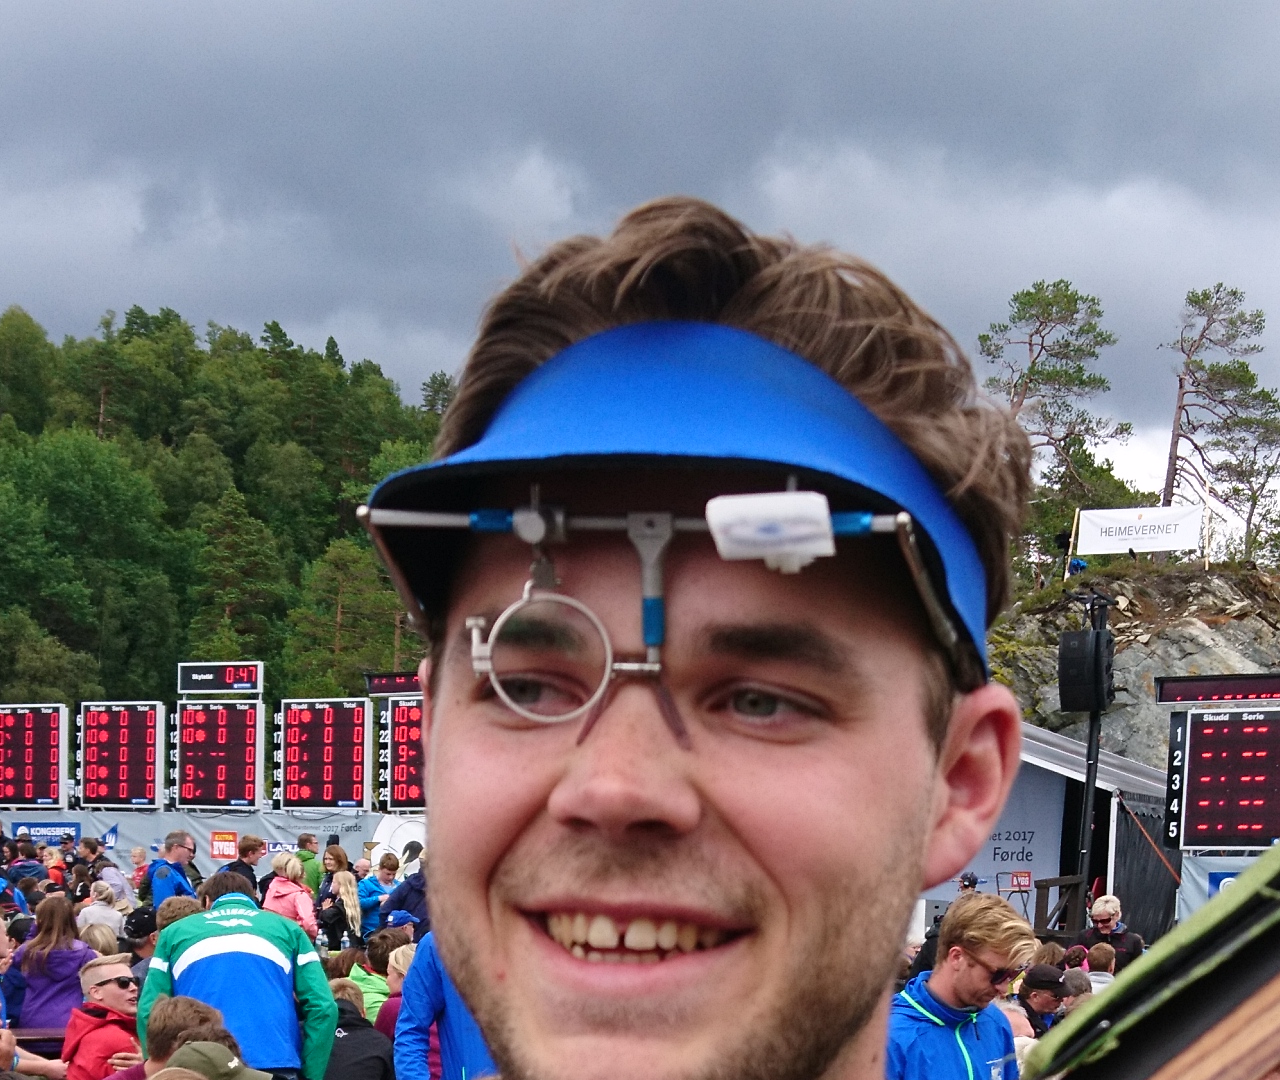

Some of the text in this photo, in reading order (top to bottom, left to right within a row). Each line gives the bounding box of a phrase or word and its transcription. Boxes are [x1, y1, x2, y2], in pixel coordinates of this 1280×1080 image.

[1100, 523, 1179, 537] HEIMEVERNET
[226, 666, 257, 684] 0:47
[1203, 713, 1229, 721] Skudd
[1176, 726, 1182, 742] 1
[1172, 750, 1182, 766] 2
[1171, 774, 1181, 790] 3
[1169, 799, 1179, 813] 4
[30, 827, 76, 836] KONGSBERG
[322, 825, 339, 834] 2017
[340, 823, 362, 832] Førde
[1168, 822, 1177, 837] 5
[1005, 831, 1035, 844] 2017
[212, 841, 236, 855] BYGG
[269, 844, 300, 852] LAPU
[993, 846, 1033, 861] Førde
